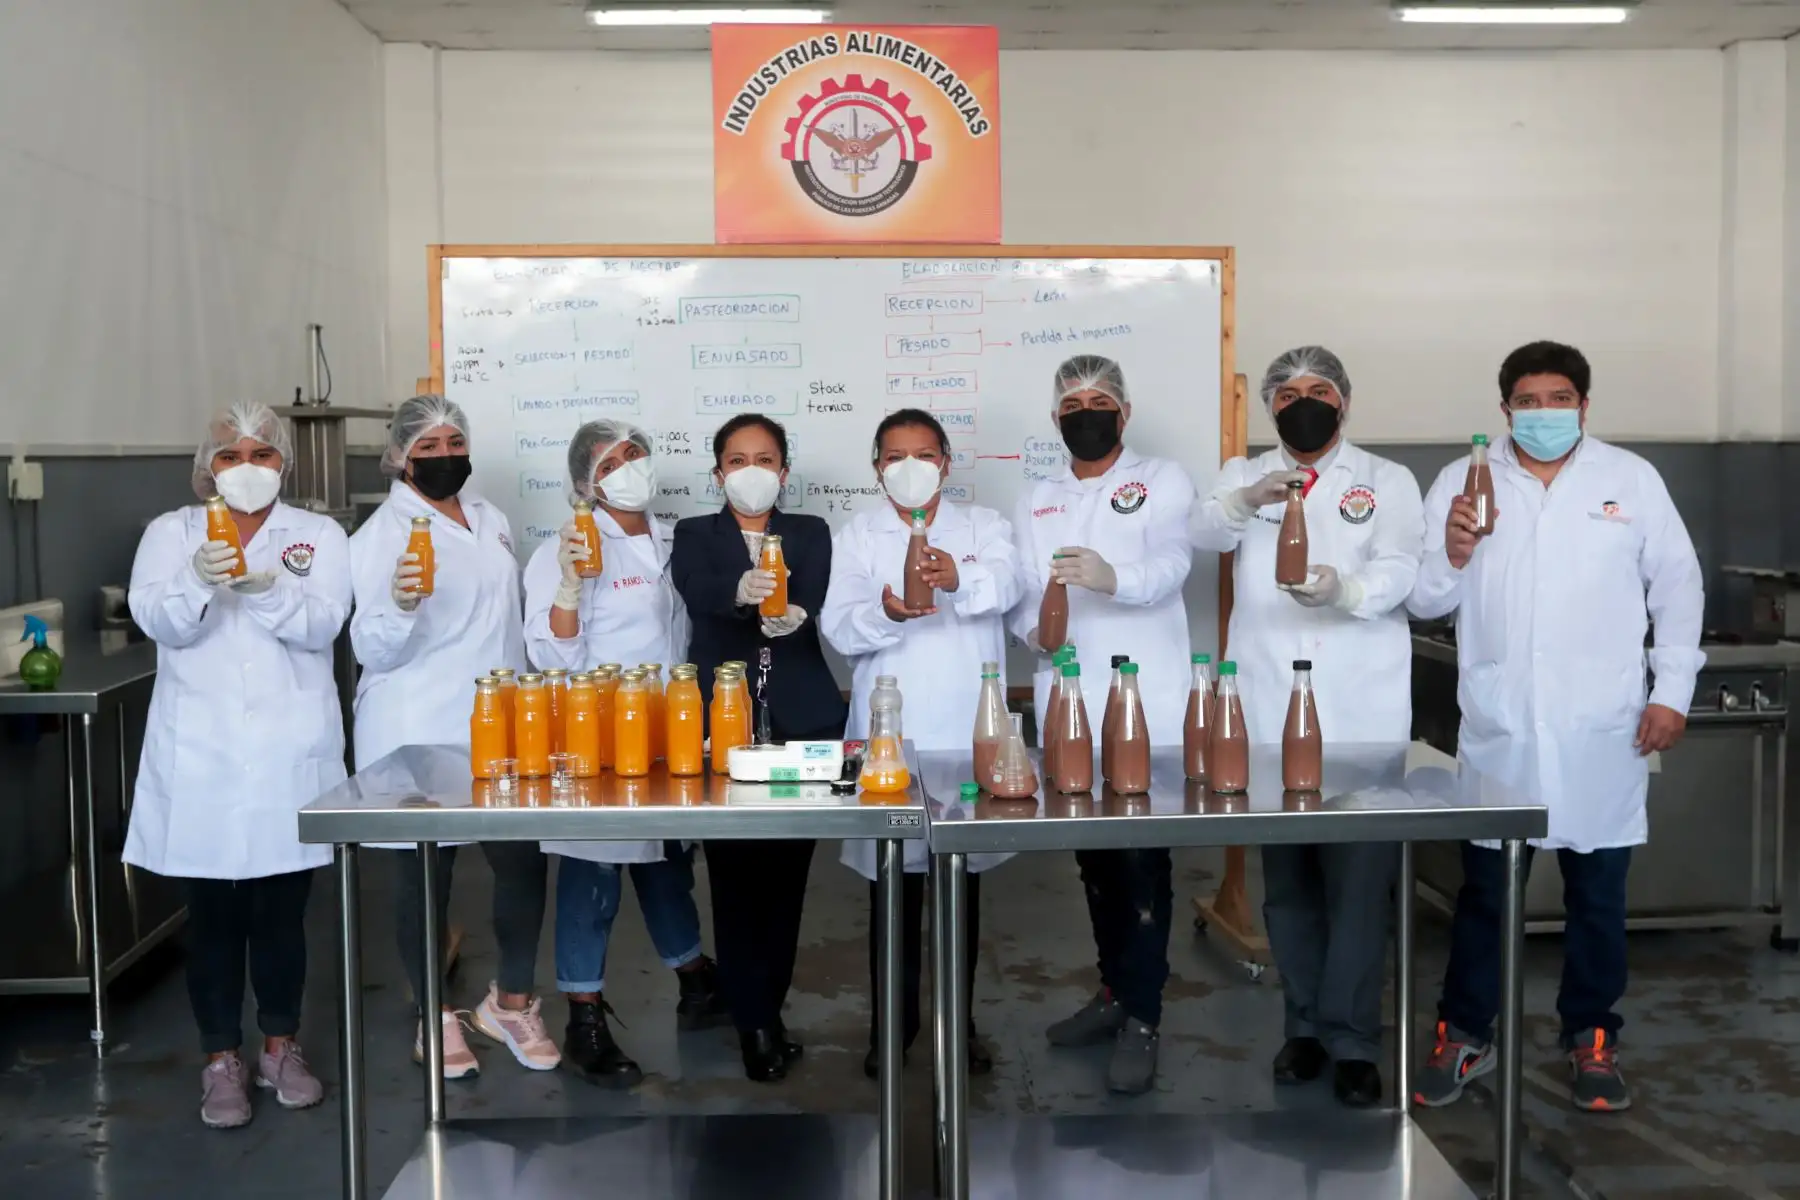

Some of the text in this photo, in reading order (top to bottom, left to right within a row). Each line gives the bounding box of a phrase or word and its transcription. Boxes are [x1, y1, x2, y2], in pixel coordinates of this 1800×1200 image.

[725, 33, 988, 136] INDUSTRIAS ALIMENTARIAS
[888, 296, 974, 312] RECEPCION
[897, 338, 951, 354] PESADO
[698, 350, 789, 364] ENVASADO
[808, 380, 846, 395] Stock
